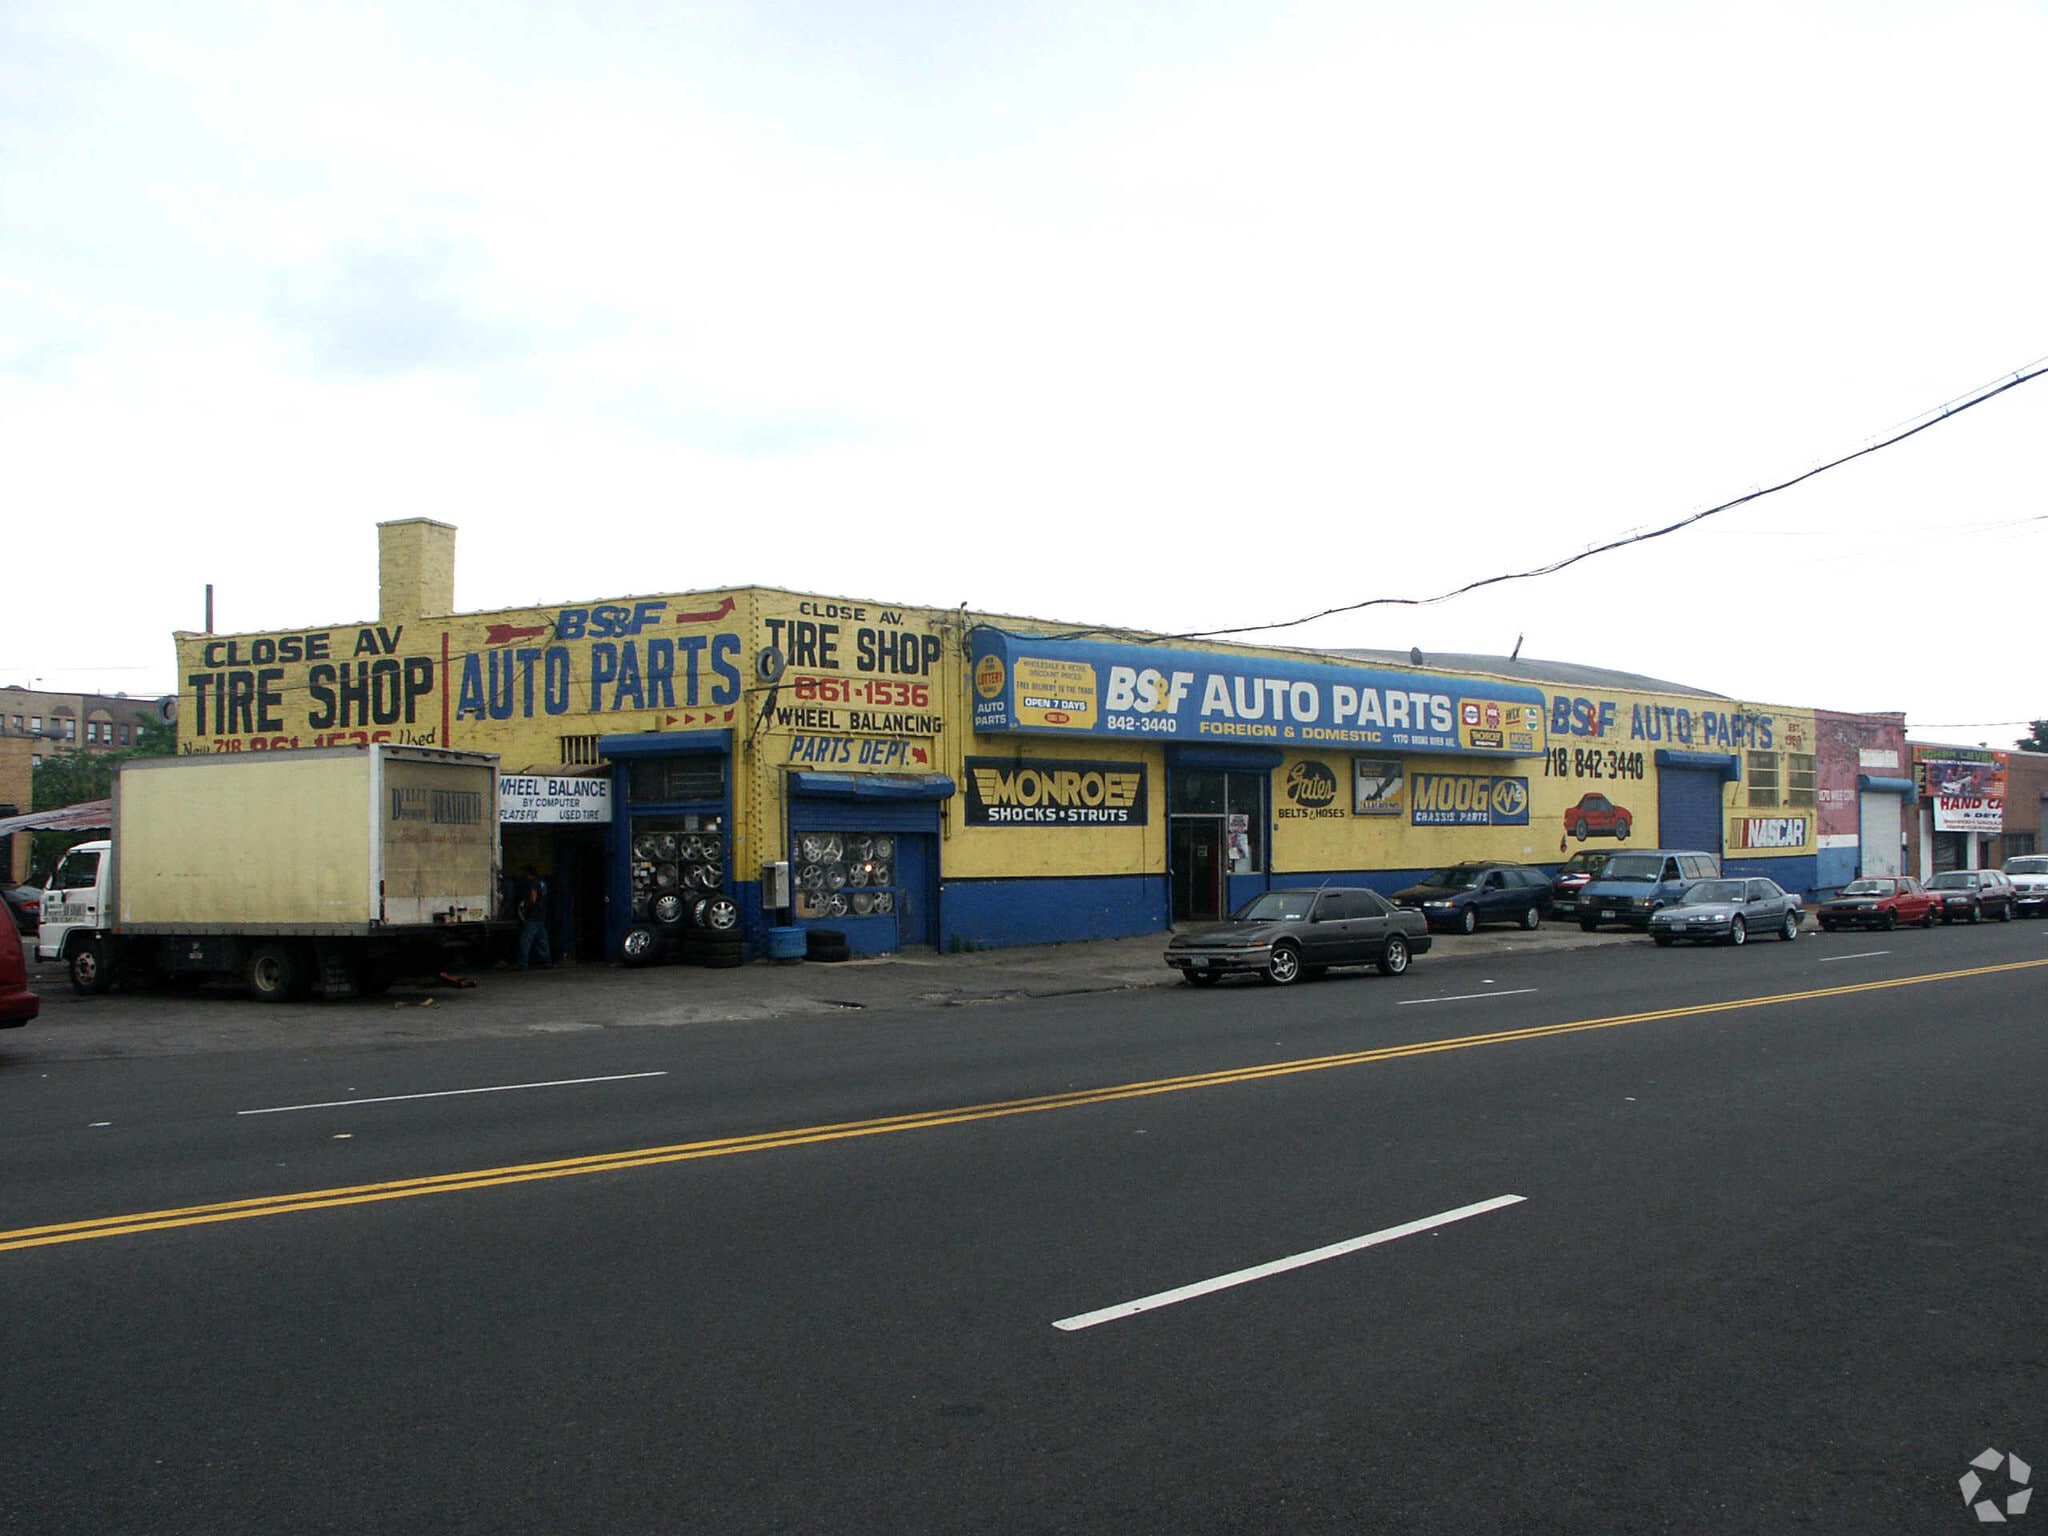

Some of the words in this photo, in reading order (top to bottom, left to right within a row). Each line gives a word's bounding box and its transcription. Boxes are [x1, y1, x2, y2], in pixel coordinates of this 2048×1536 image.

[556, 602, 667, 639] BS&F
[800, 601, 866, 622] CLOSE
[204, 633, 330, 668] CLOSE
[353, 625, 403, 657] AV
[765, 618, 839, 670] TIRE
[857, 627, 941, 676] SHOP
[456, 646, 570, 721] AUTO
[591, 633, 741, 712] PARTS
[1016, 681, 1029, 690] FREE
[188, 668, 284, 736] TIRE
[309, 656, 434, 729] SHOP
[1025, 698, 1050, 708] OPEN
[1053, 699, 1059, 707] 7
[1061, 700, 1086, 711] DAYS
[1105, 666, 1194, 714] BS&F
[1201, 674, 1319, 722] AUTO
[1332, 685, 1452, 732] PARTS
[977, 702, 1004, 713] AUTO
[776, 707, 841, 729] WHEEL
[850, 712, 943, 733] BALANCING
[975, 715, 1007, 726] PARTS
[1108, 715, 1176, 733] 842-3440
[1551, 696, 1616, 738] BS&F
[1631, 703, 1693, 744] AUTO
[1703, 711, 1773, 749] PARTS
[1200, 721, 1277, 737] FOREIGN
[1283, 726, 1295, 738] &
[1303, 727, 1382, 743] DOMESTIC
[214, 739, 242, 753] 718
[789, 735, 854, 763] PARTS
[858, 739, 911, 766] DEPT.
[500, 779, 540, 796] WHEEL
[549, 780, 606, 797] BALANCE
[988, 769, 1128, 806] MONROE
[1288, 763, 1336, 800] Gates
[522, 798, 533, 807] BY
[535, 798, 580, 808] COMPUTER
[1414, 777, 1489, 811] MOOG
[1940, 797, 1982, 811] HAND
[500, 810, 525, 820] FLATS
[525, 810, 538, 820] FIX
[559, 810, 582, 820] USED
[583, 810, 599, 820] TIRE
[988, 808, 1056, 822] SHOCKS
[1068, 809, 1128, 822] STRUTS
[1278, 809, 1308, 818] BELTS
[1316, 809, 1345, 818] HOSES
[1415, 812, 1455, 822] CHASSIS
[1460, 812, 1488, 822] PARTS
[1749, 818, 1804, 847] NASCAR
